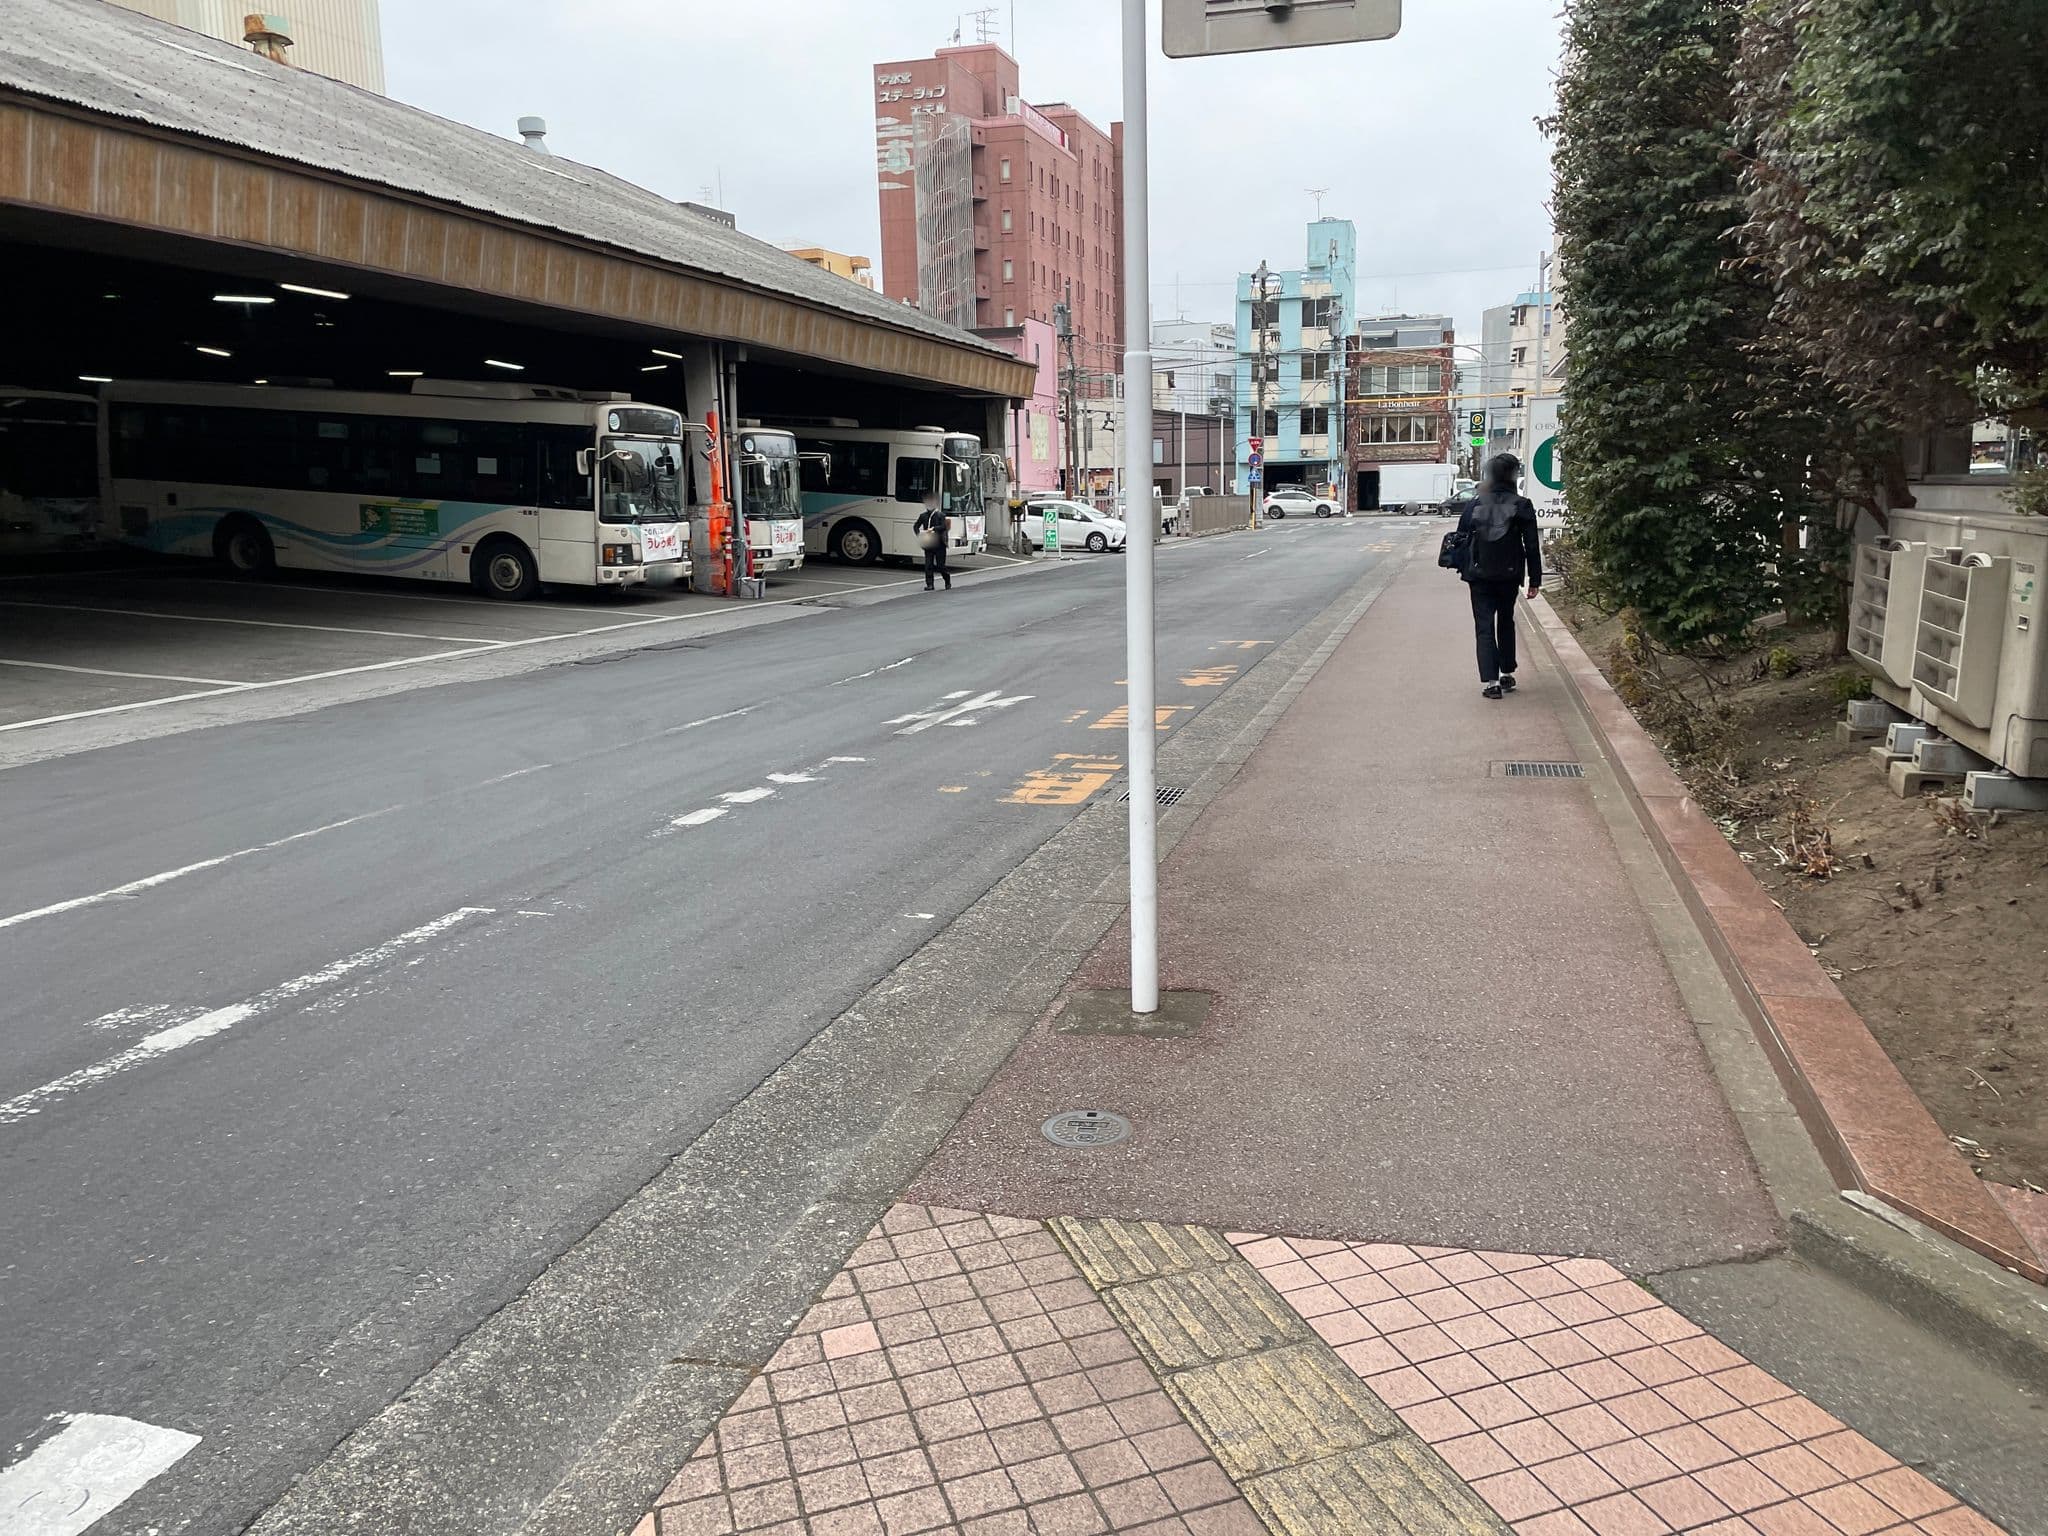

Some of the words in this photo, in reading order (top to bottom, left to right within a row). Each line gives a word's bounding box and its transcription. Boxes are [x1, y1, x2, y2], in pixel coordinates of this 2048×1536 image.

[879, 85, 946, 103] ステーション
